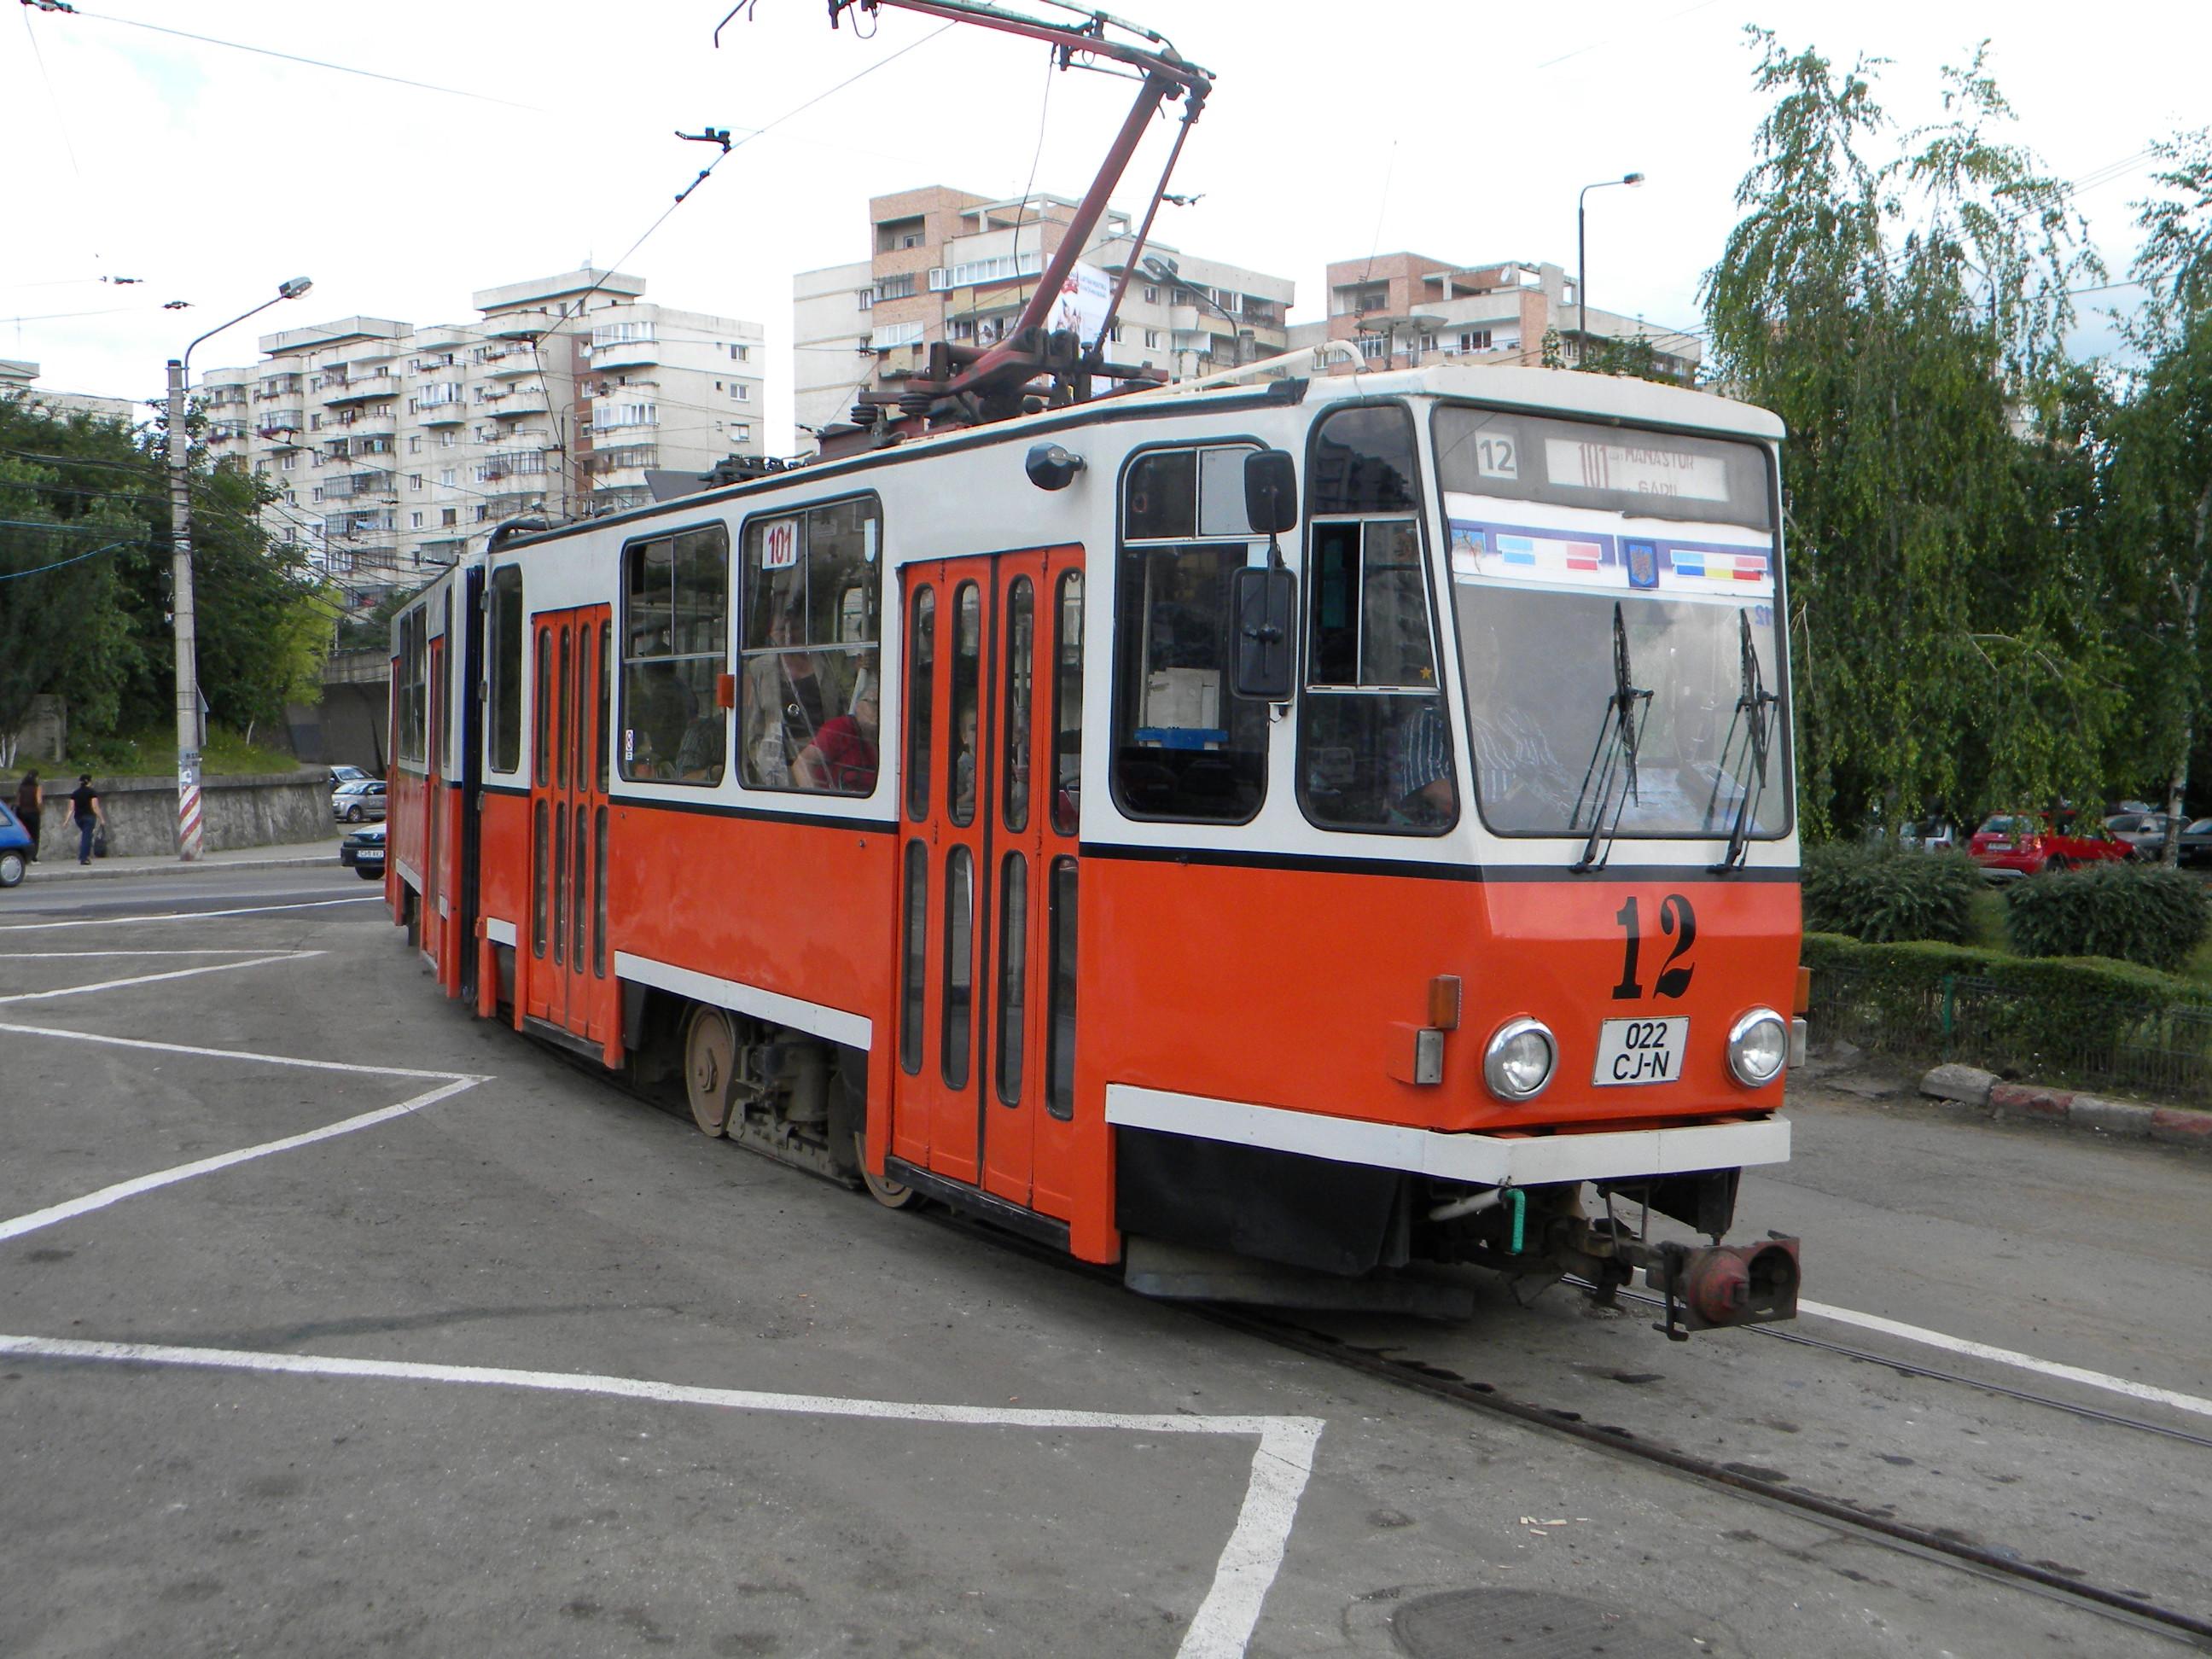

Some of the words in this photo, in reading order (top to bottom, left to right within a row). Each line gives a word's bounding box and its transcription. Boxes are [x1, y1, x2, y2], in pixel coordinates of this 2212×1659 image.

[1479, 439, 1516, 472] 12
[768, 524, 792, 565] 101
[1612, 894, 1697, 1000] 12
[1626, 1022, 1668, 1050] 022
[1612, 1051, 1670, 1080] CJ-N
